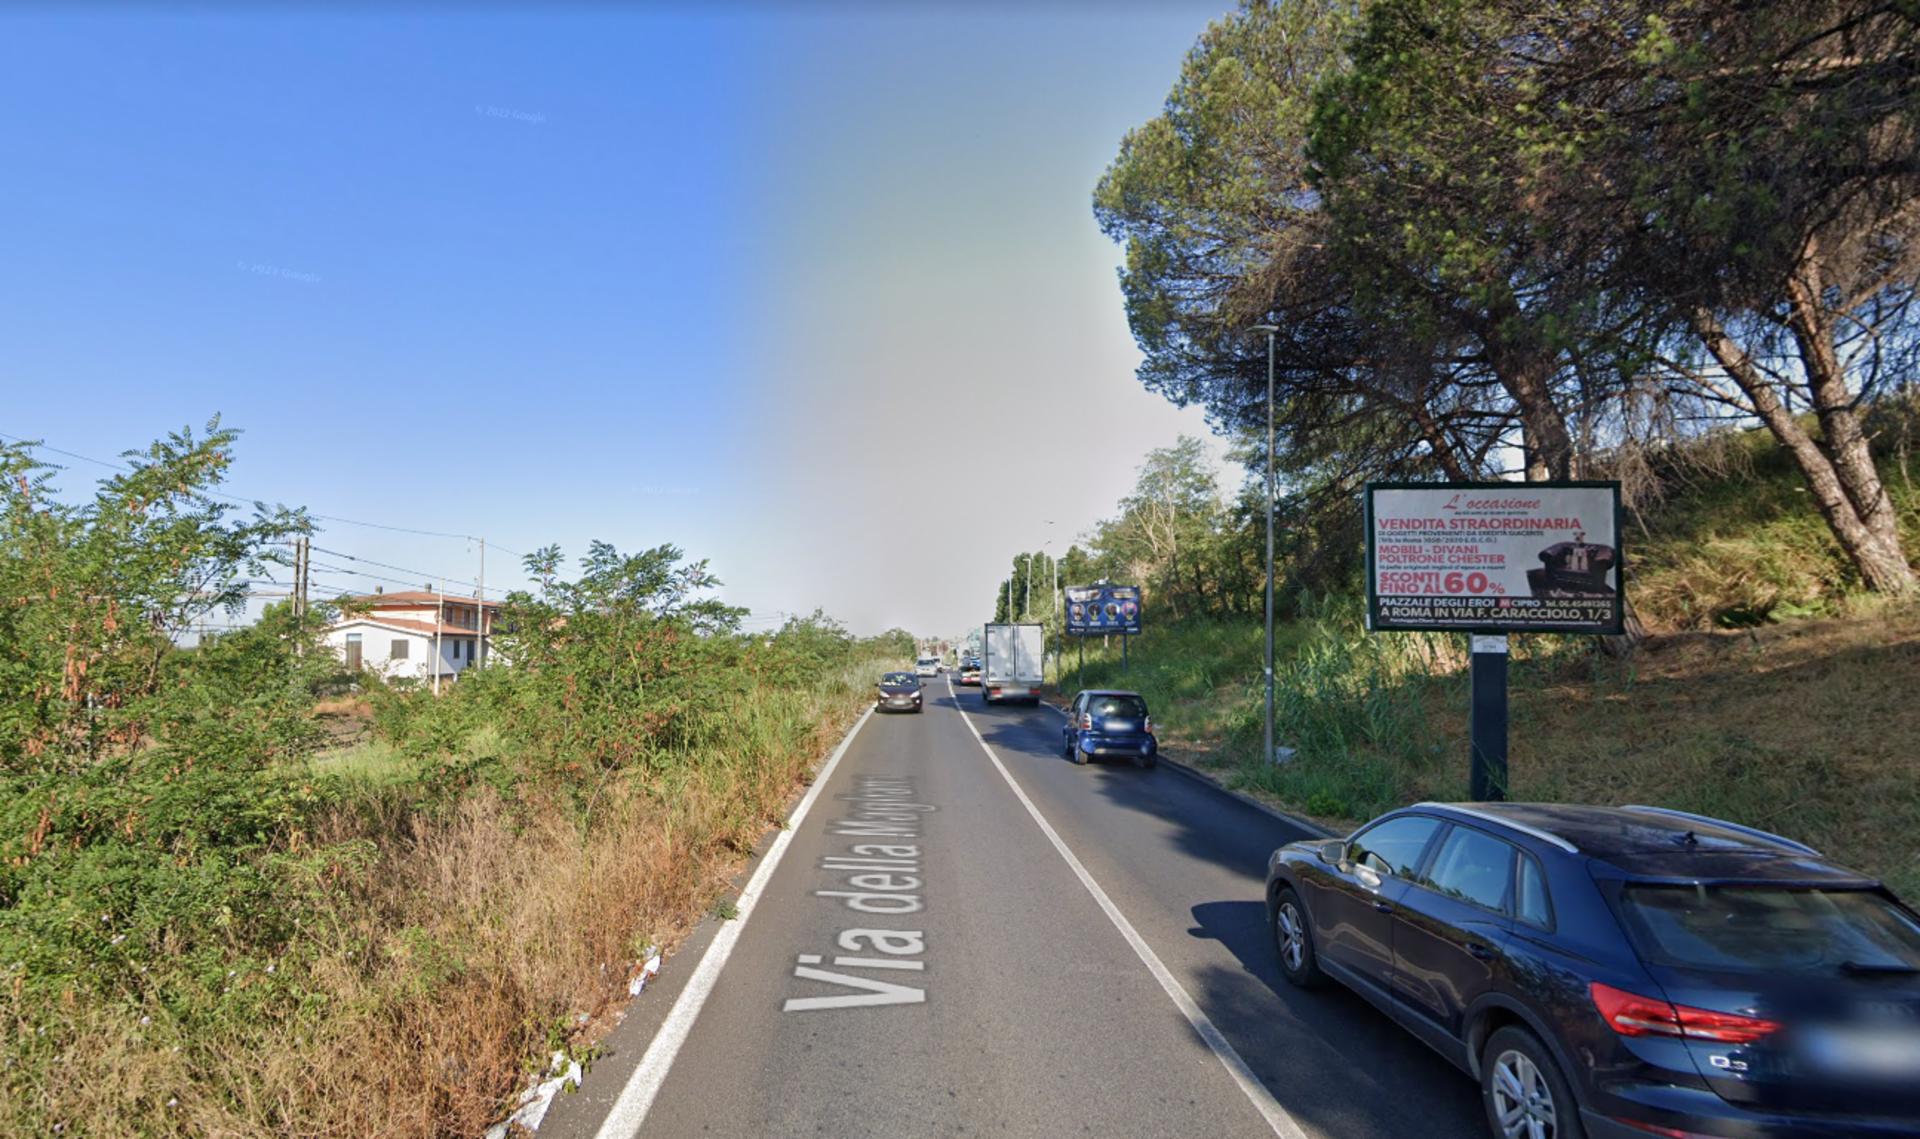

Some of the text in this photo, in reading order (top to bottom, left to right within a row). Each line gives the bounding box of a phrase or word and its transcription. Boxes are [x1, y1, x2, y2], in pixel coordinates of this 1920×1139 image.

[1442, 494, 1541, 509] L'occasione
[1378, 518, 1582, 530] VENDITA STRAORDINARIA
[1378, 545, 1423, 554] MOBILI
[1432, 545, 1479, 554] DIVANI
[1379, 554, 1505, 564] POLTRONE CHESTER
[1380, 571, 1441, 582] SCONTI
[1379, 583, 1420, 594] FINO
[1423, 583, 1444, 594] AL
[1379, 597, 1432, 606] PIAZZALE
[1433, 598, 1466, 607] DEGLI
[1468, 598, 1496, 607] EROI
[1511, 599, 1541, 607] CIPRO
[1381, 608, 1612, 620] A ROMA IN VIA F. CARACCIOLO, 1/3
[1710, 1055, 1748, 1071] Q3
